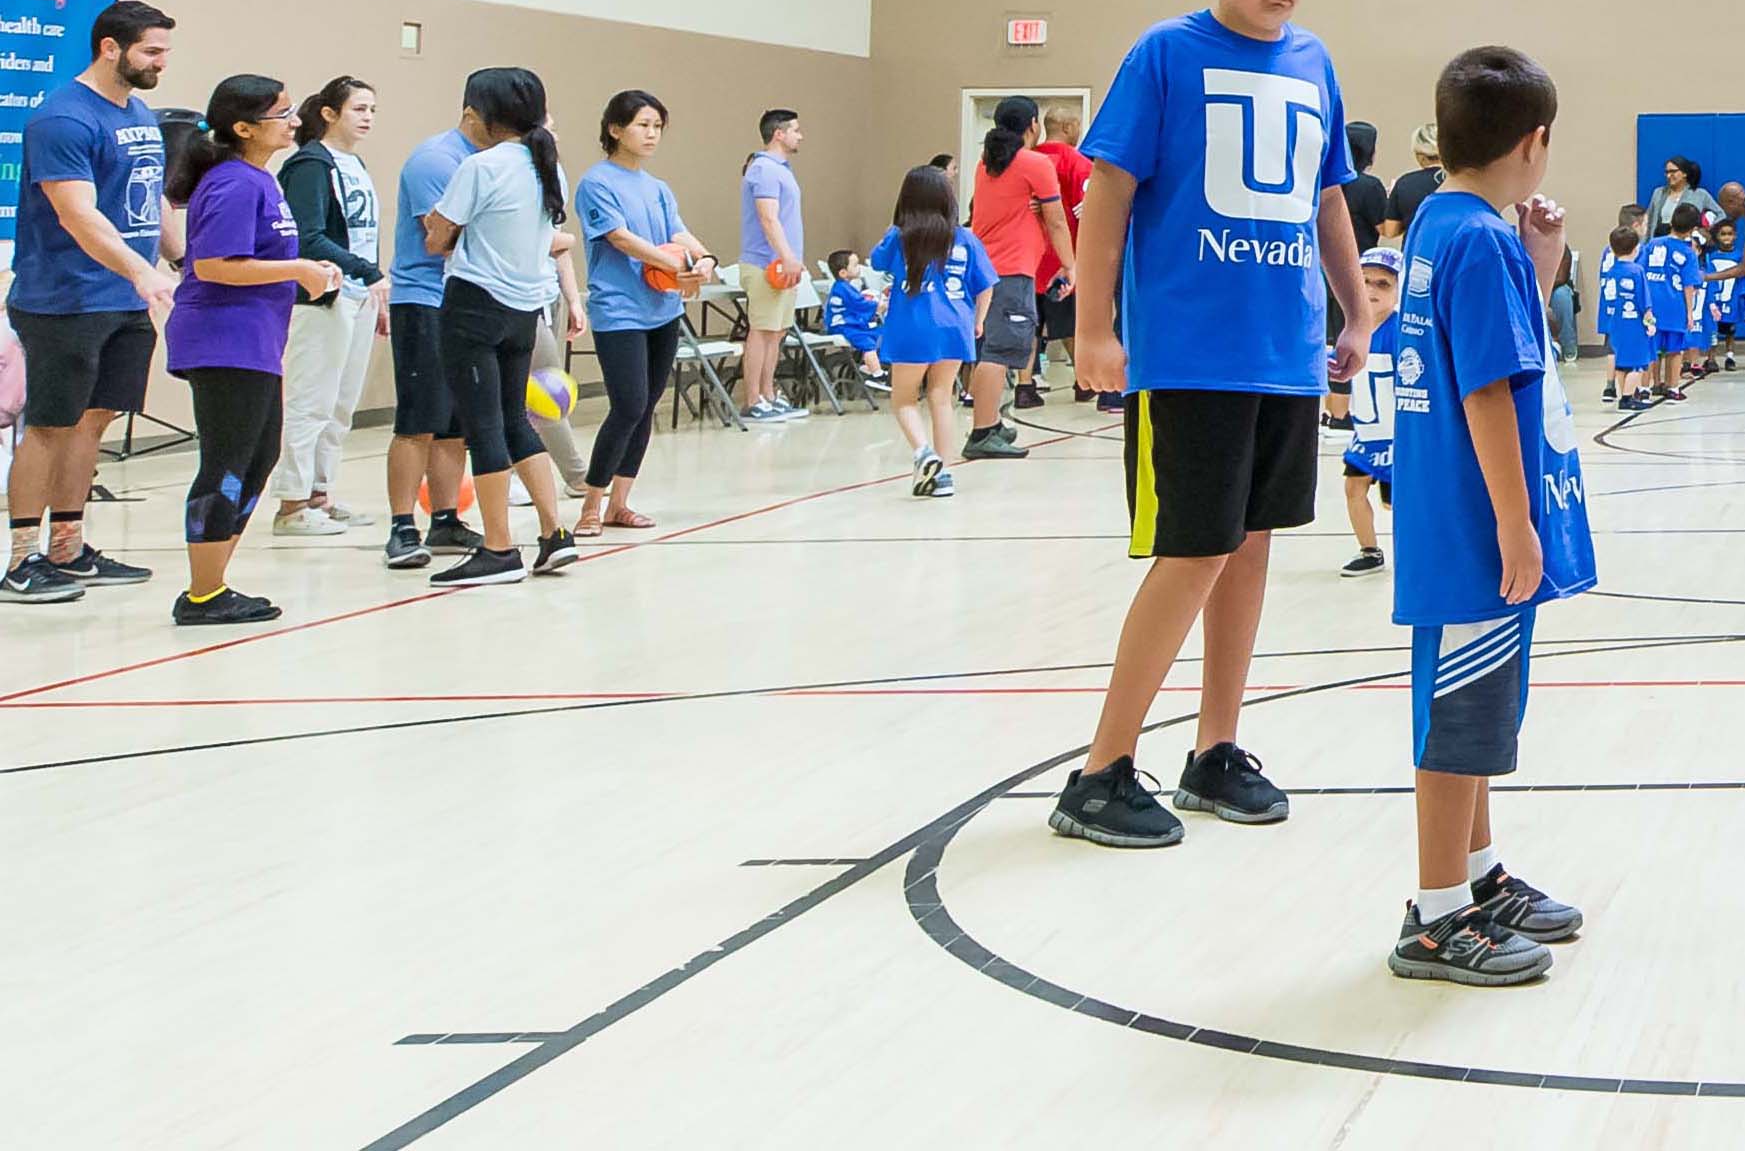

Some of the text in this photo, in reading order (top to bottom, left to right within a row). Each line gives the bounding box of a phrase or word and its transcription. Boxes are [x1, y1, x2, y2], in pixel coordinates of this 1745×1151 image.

[1015, 22, 1040, 42] EXIT
[32, 55, 54, 73] and
[30, 90, 46, 109] of
[345, 189, 377, 228] 21
[1197, 228, 1313, 269] Nevada
